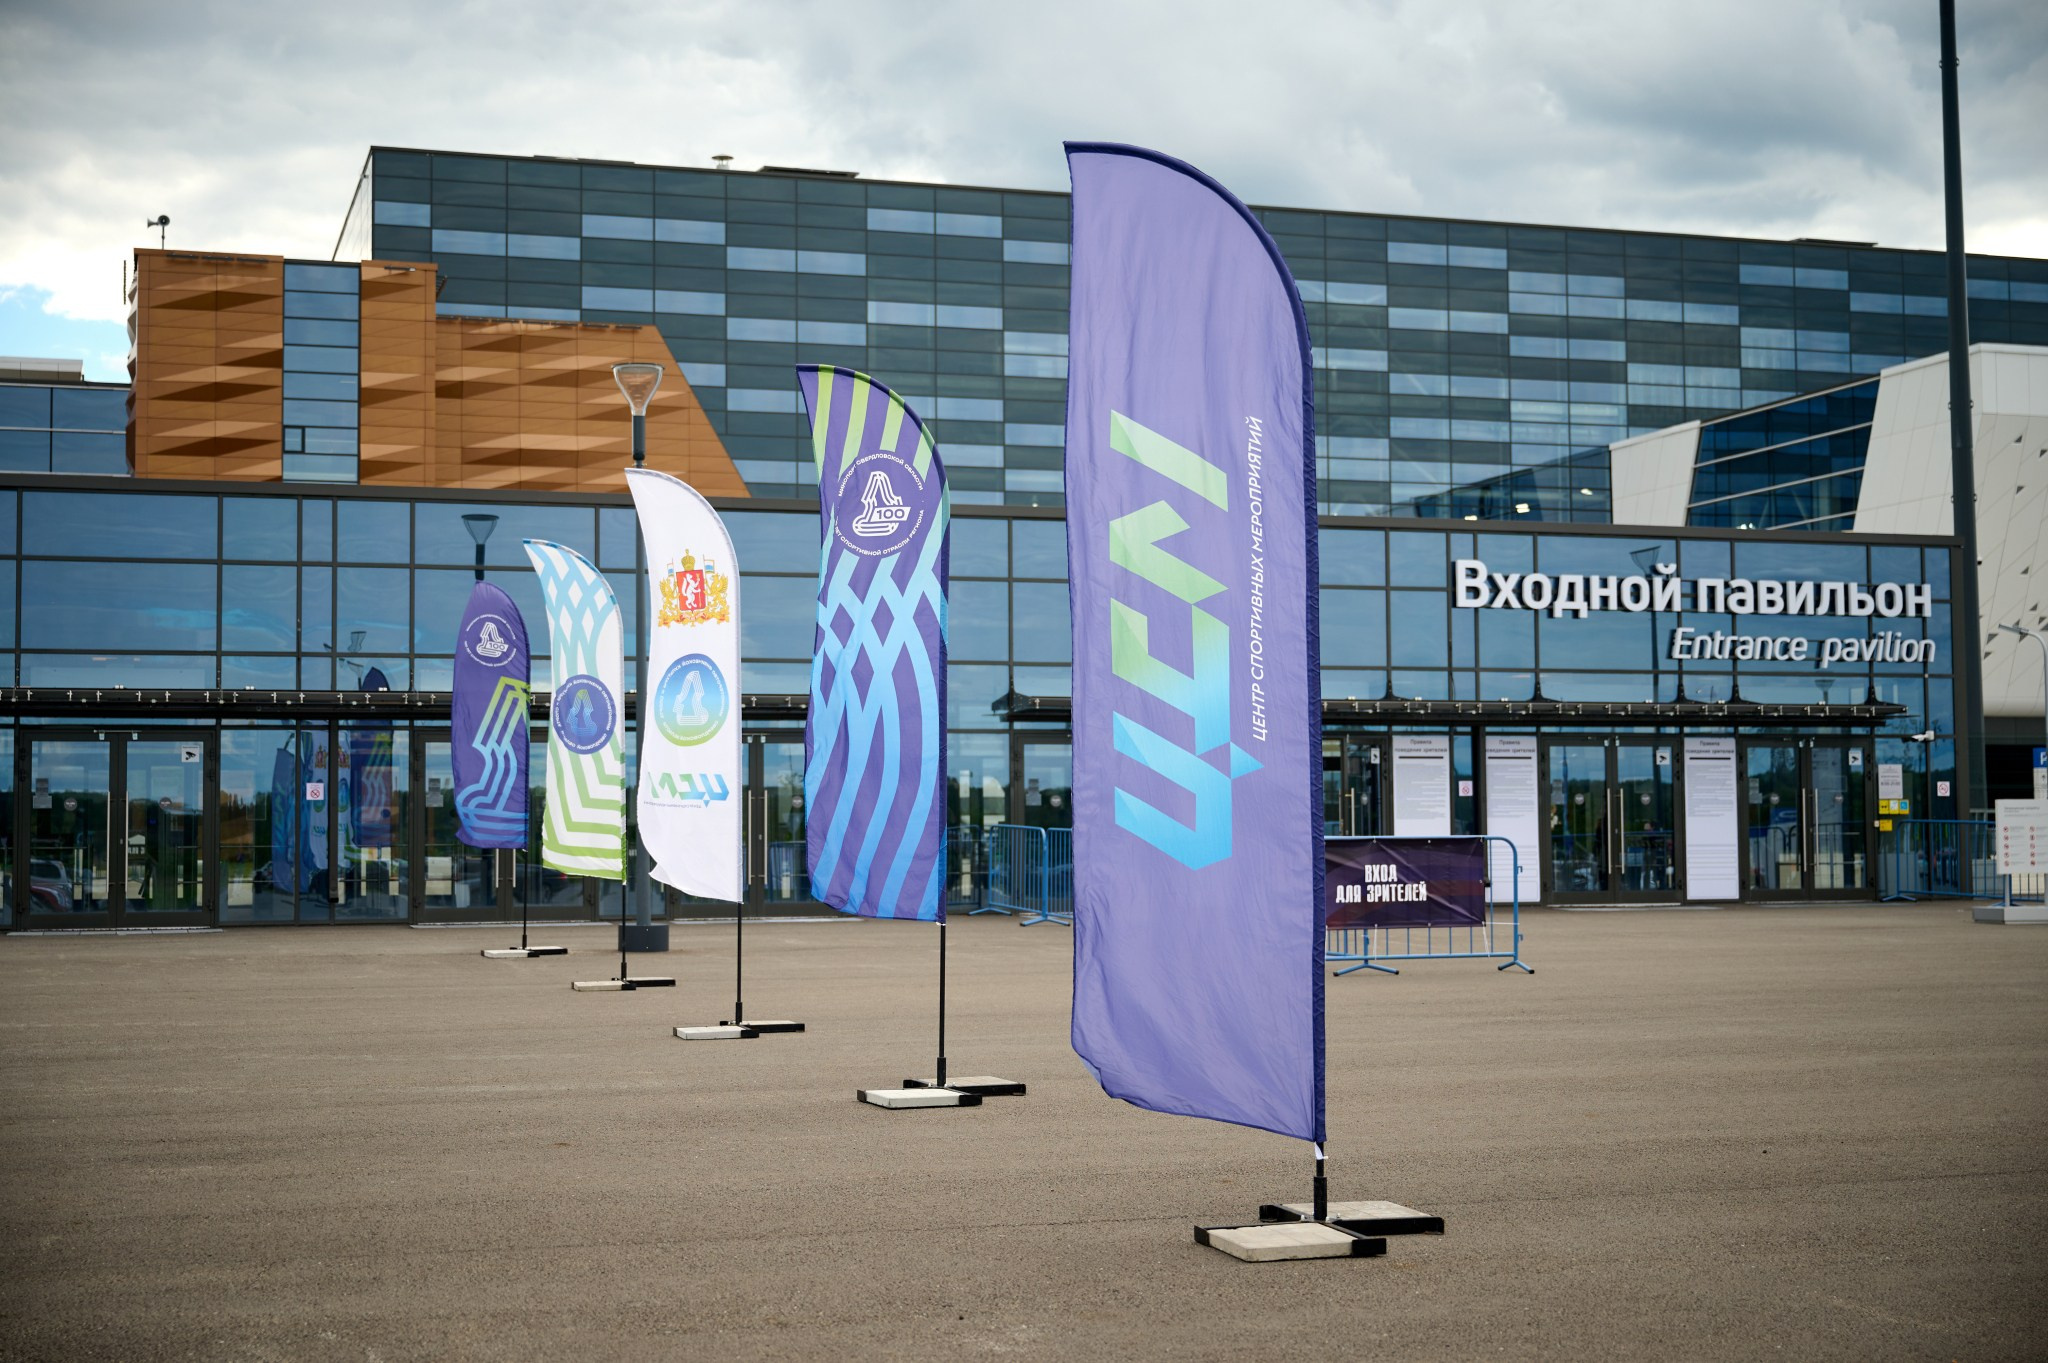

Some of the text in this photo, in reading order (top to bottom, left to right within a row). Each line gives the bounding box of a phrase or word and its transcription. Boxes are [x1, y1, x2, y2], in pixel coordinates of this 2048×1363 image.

[838, 453, 924, 497] МИНСПОРТ СВЕРДЛОВСКОЙ ОБЛАСТИ
[840, 535, 882, 556] СПОРТИВНОЙ
[882, 537, 910, 555] ОТРАСЛИ
[908, 509, 925, 539] РЕГИОНА
[876, 508, 905, 520] 100
[1245, 415, 1267, 741] ЦЕНТР СПОРТИВНЫХ МЕРОПРИЯТИЙ
[1455, 559, 1932, 619] Входной павильон
[489, 642, 506, 651] 100
[1671, 627, 1936, 669] Entrance pavilion
[1335, 881, 1427, 903] ДЛЯ ЗРИТЕЛЕЙ
[1364, 864, 1398, 883] ВХОД
